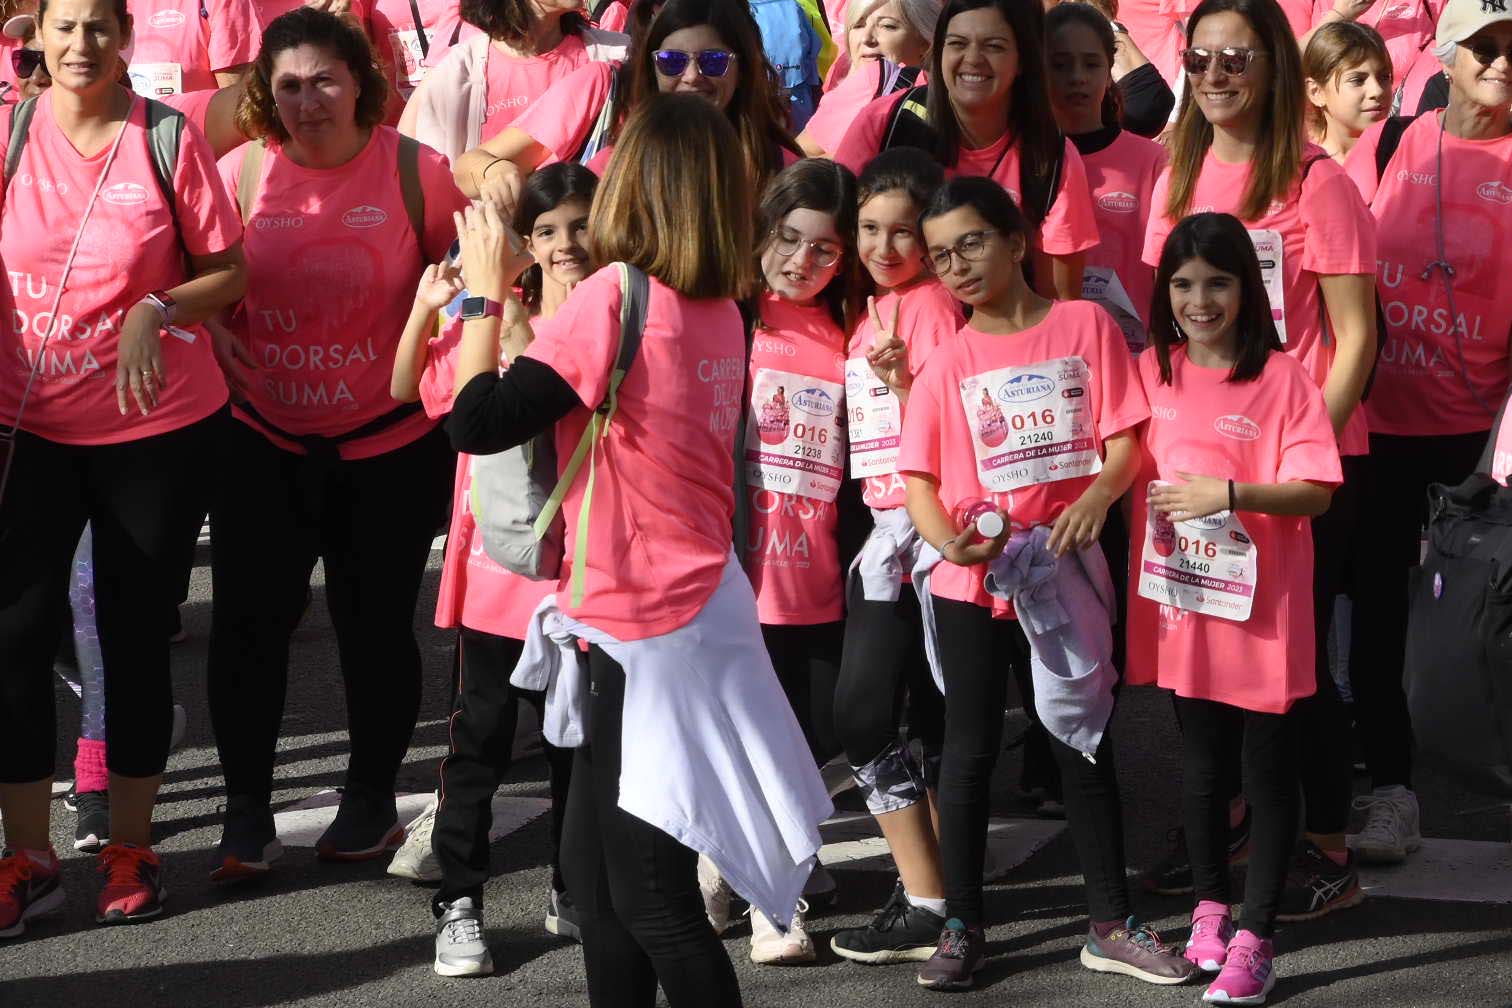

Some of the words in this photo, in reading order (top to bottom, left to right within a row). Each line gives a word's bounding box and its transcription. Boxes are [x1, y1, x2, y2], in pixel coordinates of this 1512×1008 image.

[486, 95, 529, 117] OYSHO
[255, 216, 304, 230] OYSHO
[1255, 244, 1274, 252] UMA
[9, 270, 48, 300] TU
[261, 309, 297, 333] TU
[1385, 301, 1484, 342] ORSAL
[16, 349, 101, 376] SUMA
[264, 338, 378, 371] DORSAL
[1381, 340, 1446, 368] UMA
[266, 378, 355, 407] SUMA
[1003, 383, 1051, 400] ASTURIANA
[794, 395, 833, 413] ASTURIANA
[1011, 408, 1055, 431] 016
[793, 423, 827, 444] 016
[1019, 431, 1053, 446] 21240
[759, 454, 793, 468] CARRERA
[794, 459, 804, 469] DE
[804, 461, 813, 471] LA
[794, 445, 822, 459] 21238
[992, 452, 1025, 466] CARRERA
[1025, 449, 1036, 458] DE
[1037, 447, 1048, 456] LA
[1048, 443, 1073, 454] MUJER
[752, 471, 792, 485] OYSHO
[992, 467, 1028, 485] OYSHO
[749, 526, 810, 558] UMA
[1178, 536, 1217, 559] 016
[1179, 558, 1211, 574] 21440
[1179, 572, 1191, 583] DE
[1191, 575, 1201, 585] LA
[1201, 577, 1225, 590] MUJER
